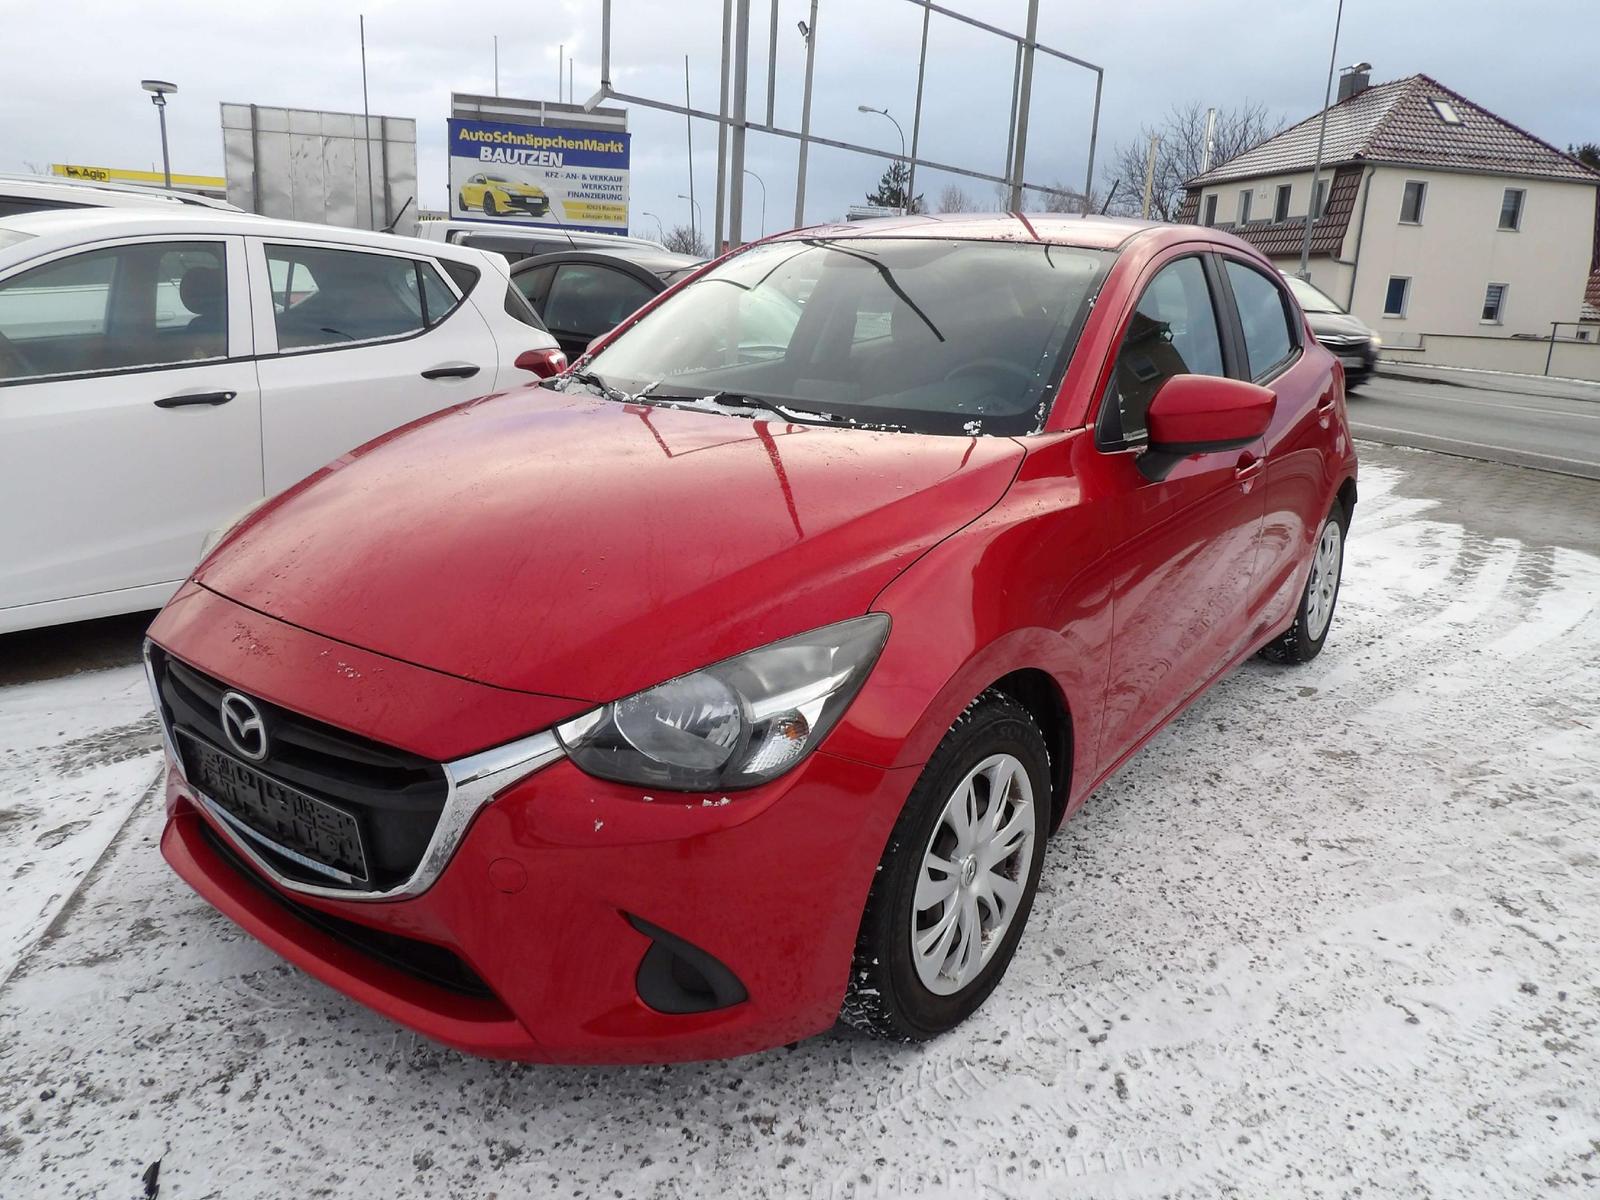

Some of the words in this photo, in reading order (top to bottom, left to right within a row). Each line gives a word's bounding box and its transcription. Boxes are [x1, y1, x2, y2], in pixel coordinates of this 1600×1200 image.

[459, 128, 624, 153] AutoSchnäppchenMarkt
[479, 146, 563, 168] BAUTZEN
[82, 168, 106, 180] Agip
[589, 174, 623, 182] VERKAUF
[581, 183, 623, 191] WERKSTATT
[567, 191, 623, 200] FINANZIERUNG
